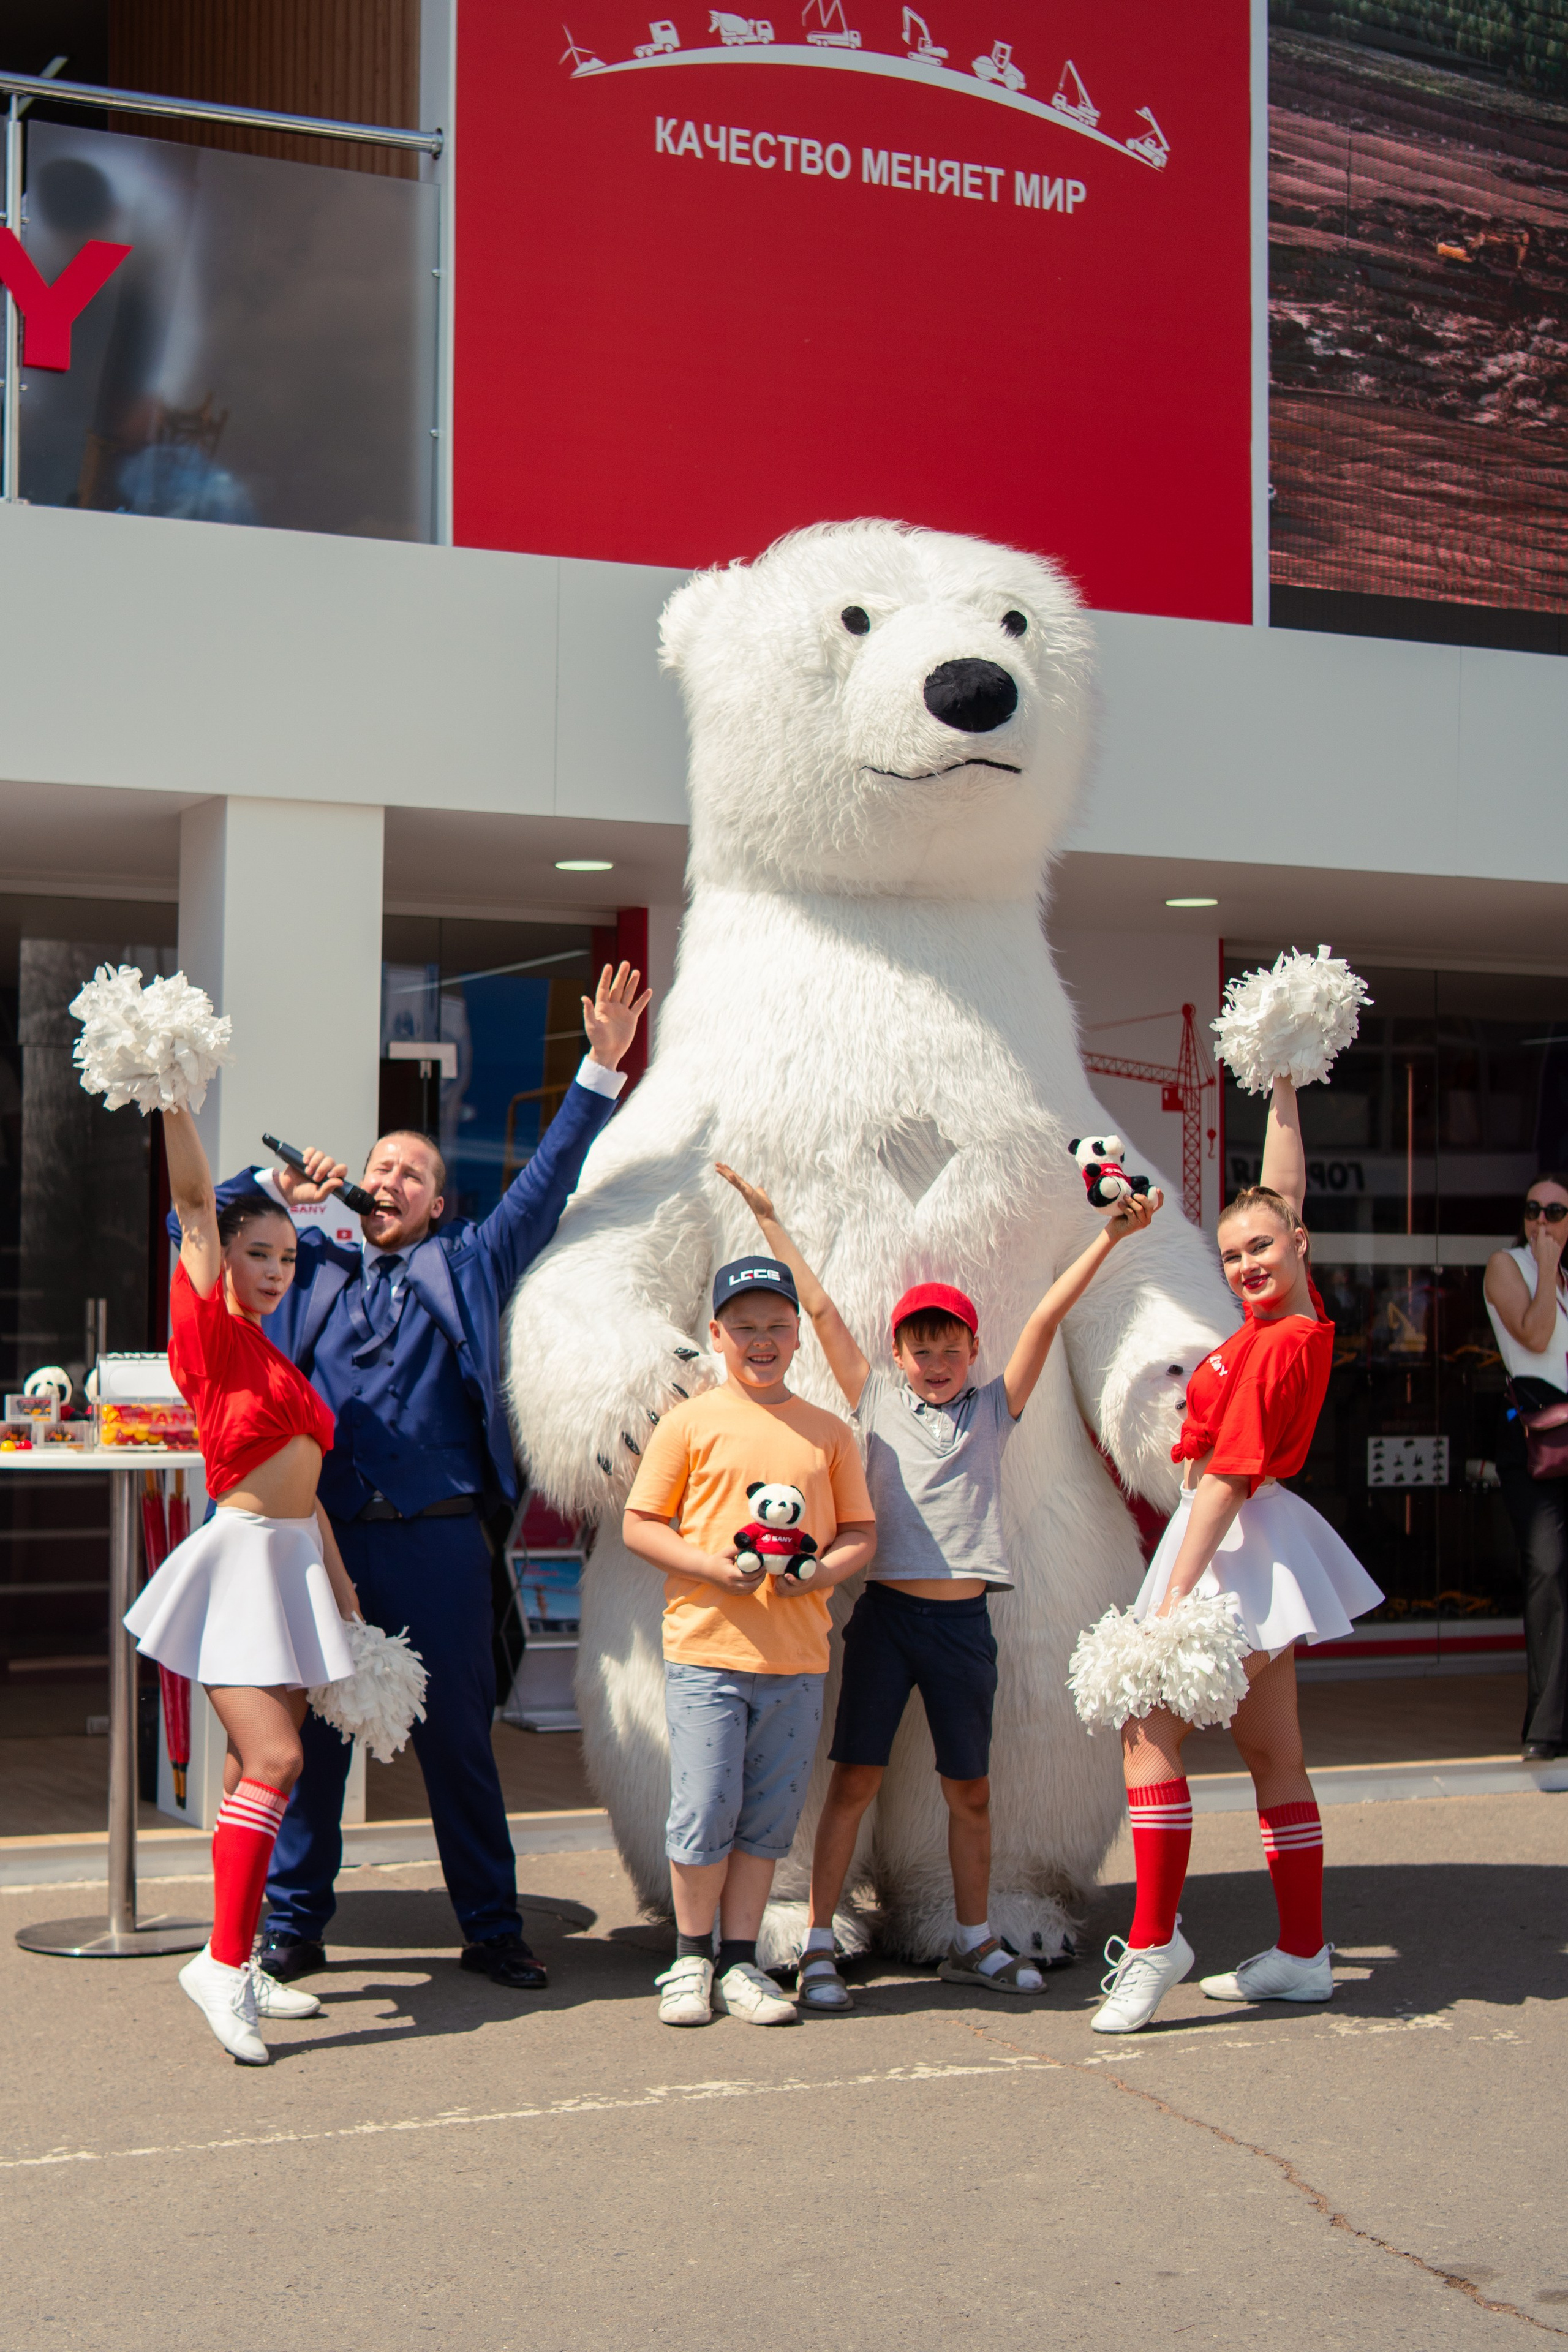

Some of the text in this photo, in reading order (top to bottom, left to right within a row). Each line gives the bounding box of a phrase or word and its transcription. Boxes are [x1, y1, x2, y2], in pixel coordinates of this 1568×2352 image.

[655, 116, 1087, 214] КАЧЕСТВО МЕНЯЕТ МИР
[290, 1204, 326, 1213] SANY
